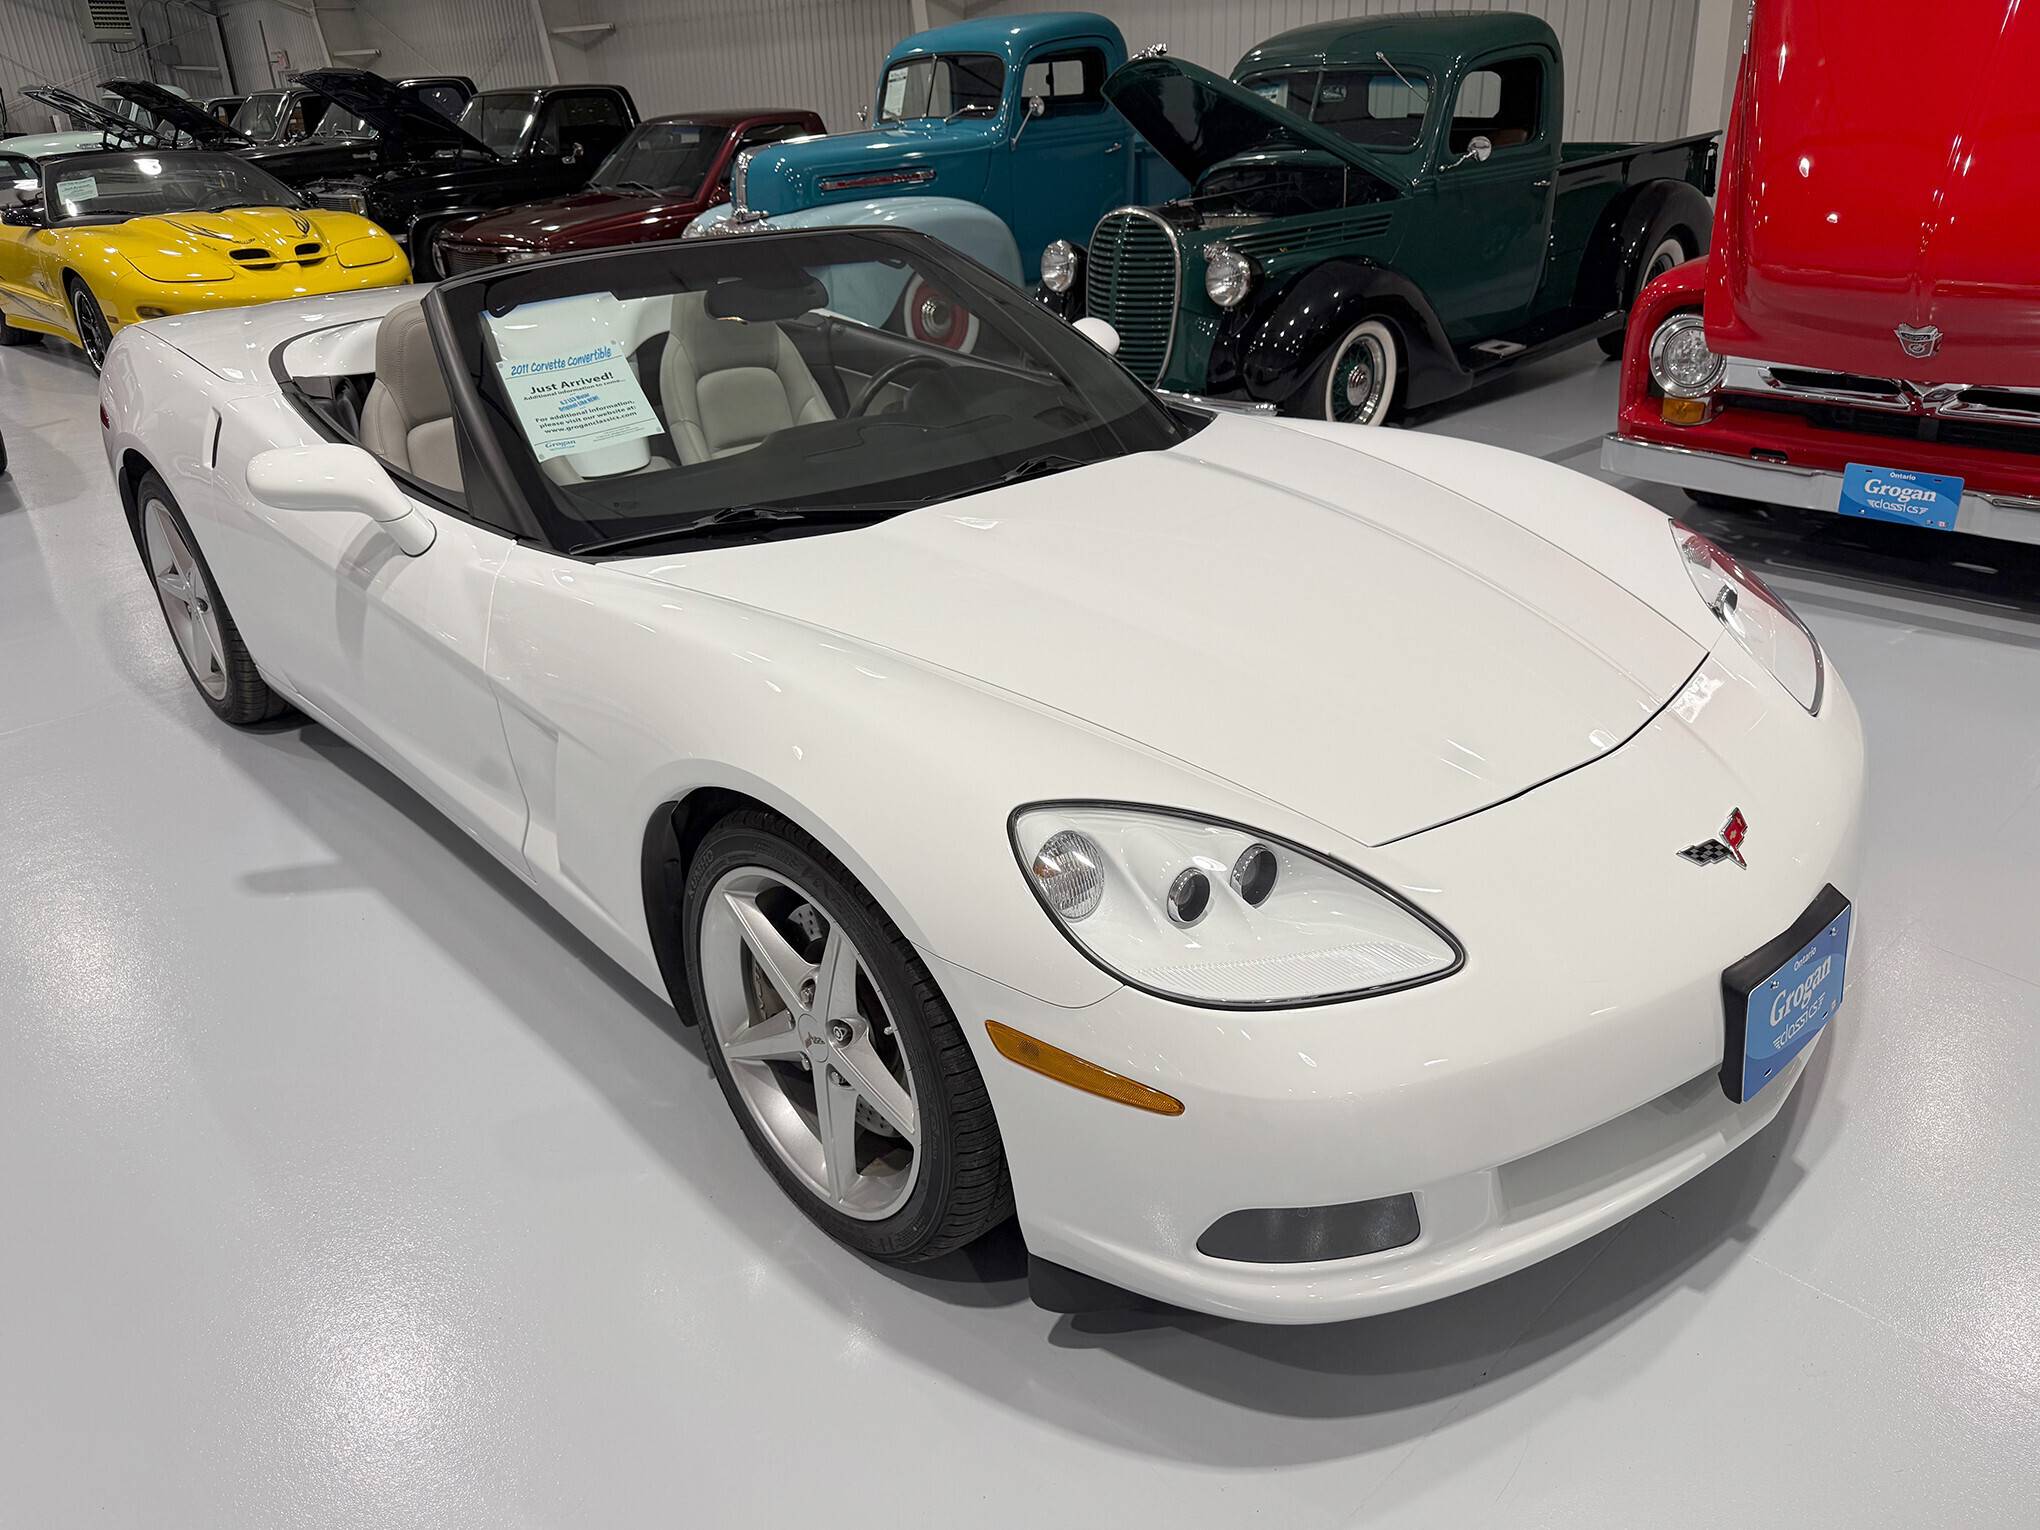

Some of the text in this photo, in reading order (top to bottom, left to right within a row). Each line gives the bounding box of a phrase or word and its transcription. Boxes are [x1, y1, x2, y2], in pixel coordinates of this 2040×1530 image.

[511, 346, 612, 376] 2011 Corvette Convertible
[530, 371, 614, 395] Just Arrived!
[523, 391, 557, 400] Additional
[539, 421, 564, 429] please
[596, 408, 625, 418] website
[544, 411, 638, 434] www.groganclassics.com
[550, 410, 588, 421] additional
[1889, 472, 1917, 481] Ontario
[1864, 478, 1937, 503] Grogan
[1873, 498, 1919, 514] classics
[1794, 946, 1817, 971] Ontario
[1770, 955, 1832, 1027] Grogan
[1780, 996, 1820, 1046] classics
